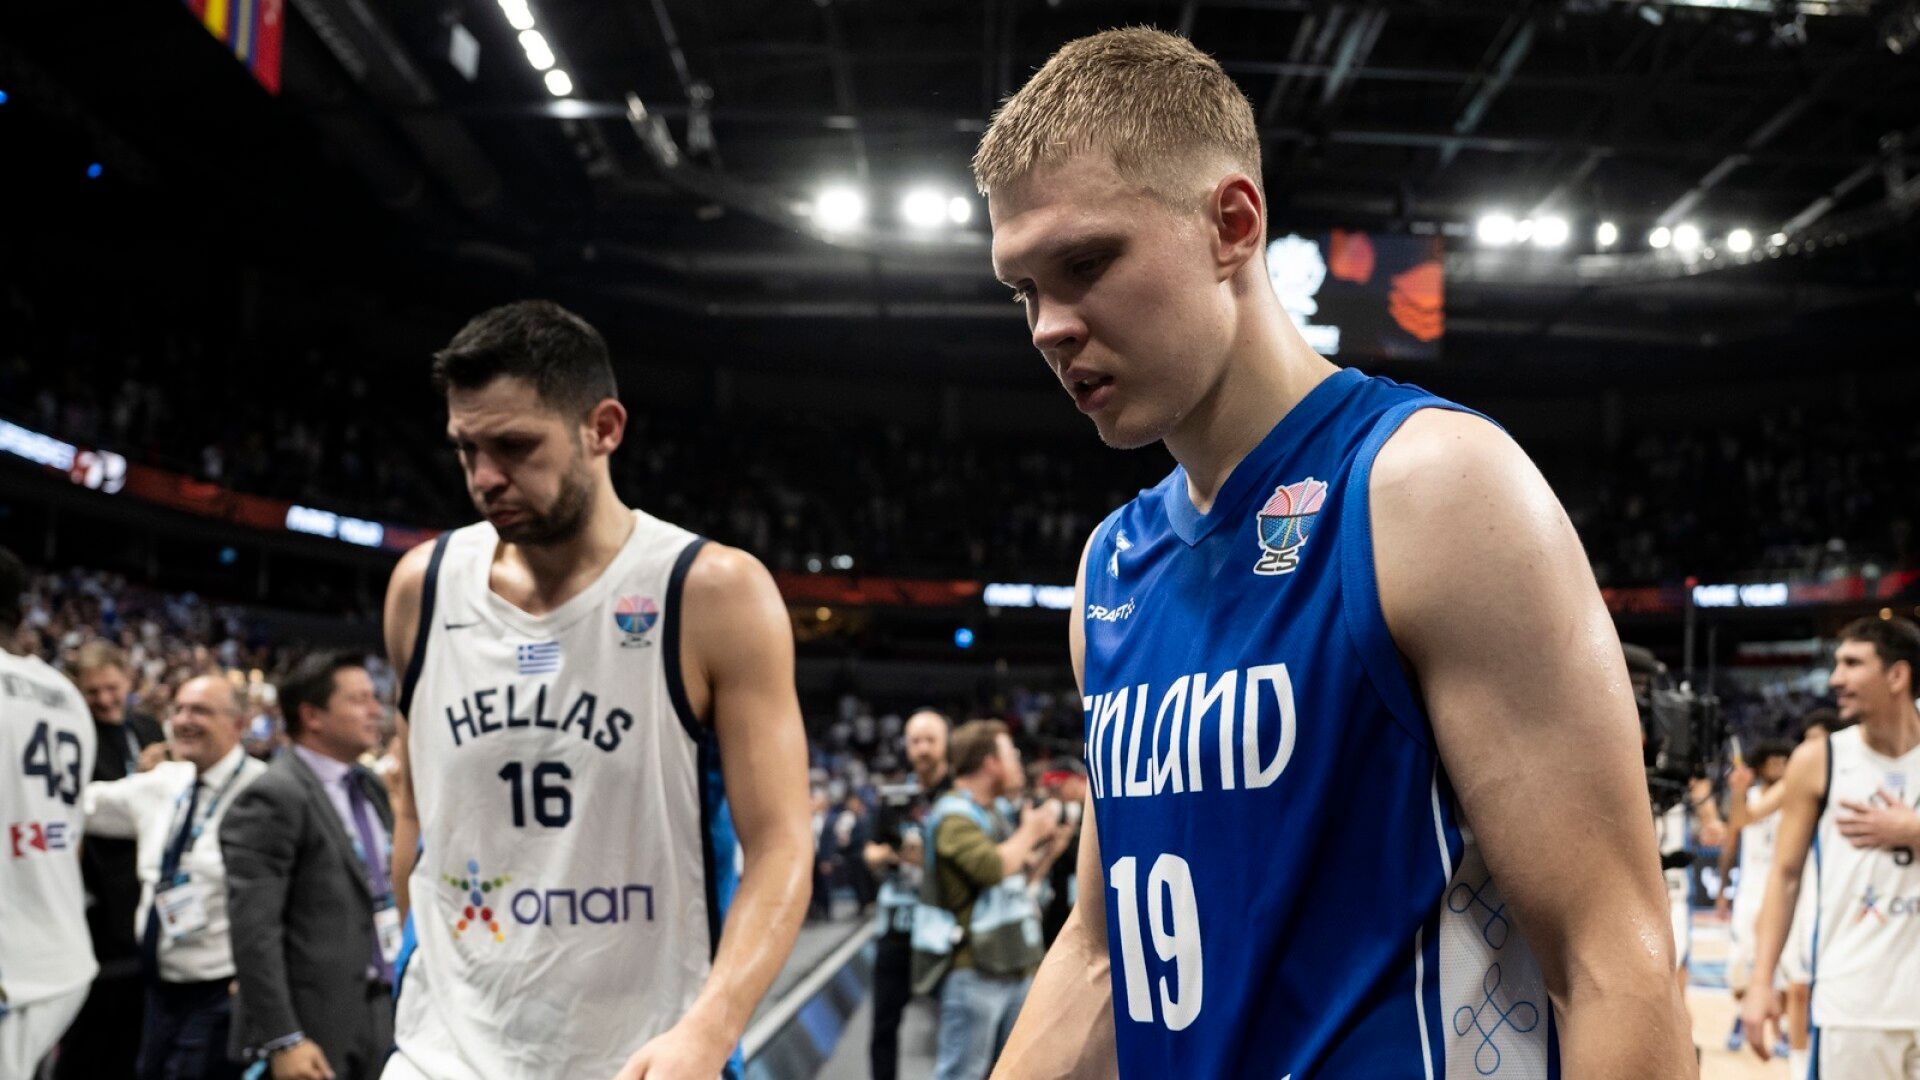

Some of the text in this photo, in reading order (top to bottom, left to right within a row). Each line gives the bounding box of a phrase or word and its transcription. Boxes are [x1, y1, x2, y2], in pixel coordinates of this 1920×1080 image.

[1255, 549, 1297, 572] 25
[1087, 603, 1129, 622] CRAFT
[446, 684, 633, 752] HELLAS
[23, 719, 81, 805] 43
[498, 761, 572, 828] 16
[1110, 853, 1203, 1031] 19
